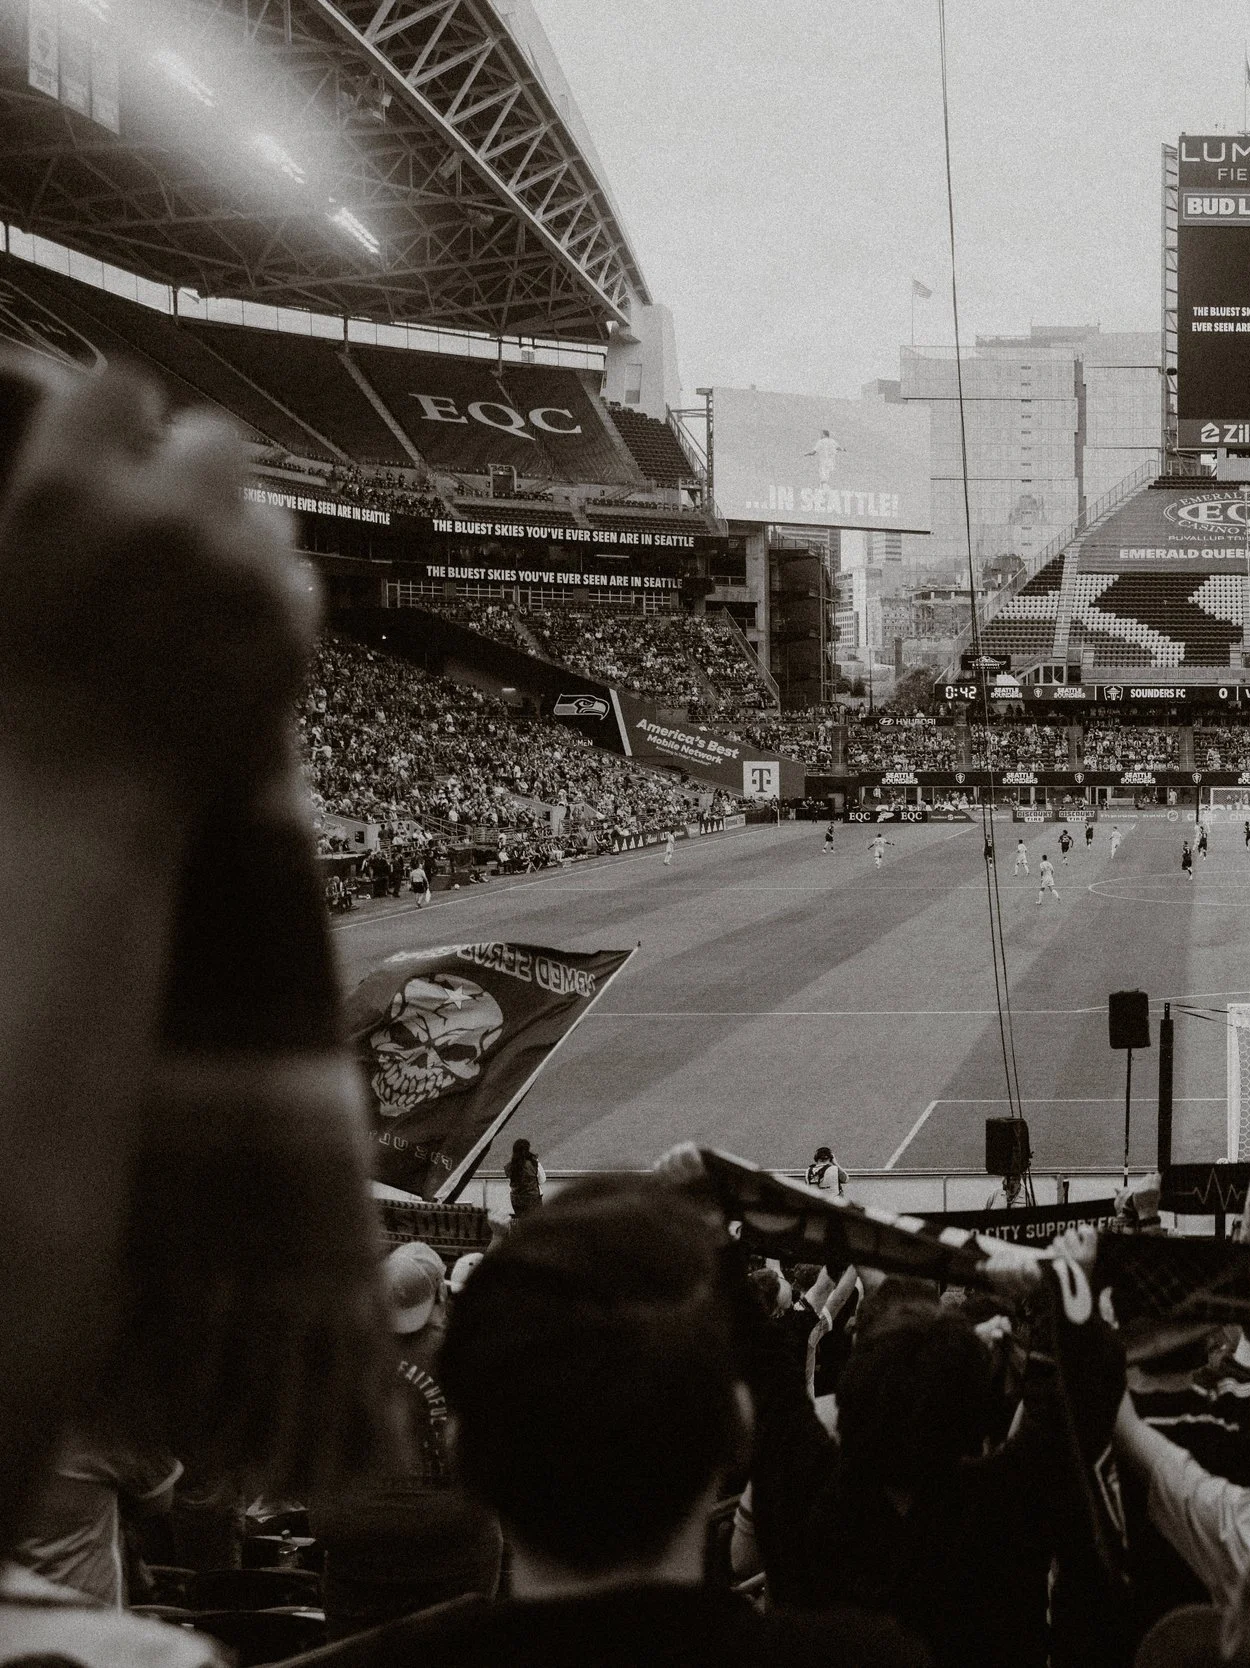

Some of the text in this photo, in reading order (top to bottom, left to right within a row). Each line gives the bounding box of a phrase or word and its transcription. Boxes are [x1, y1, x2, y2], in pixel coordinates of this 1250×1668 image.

[1187, 197, 1236, 216] BUD
[1193, 306, 1208, 317] THE
[1210, 306, 1240, 317] BLUEST
[1192, 322, 1212, 332] EVER
[1214, 322, 1234, 332] SEEN
[408, 393, 582, 441] EQC
[267, 491, 297, 509] YOU'VE
[297, 497, 317, 512] EVER
[318, 501, 337, 517] SEEN
[337, 504, 352, 519] ARE
[352, 506, 361, 520] IN
[362, 508, 390, 525] SEATTLE
[433, 519, 694, 547] THE BLUEST SKIES YOU'VE EVER SEEN ARE IN SEATTLE
[1178, 519, 1240, 535] CASINO
[1119, 549, 1199, 560] EMERALD
[427, 565, 683, 589] THE BLUEST SKIES YOU'VE EVER SEEN ARE IN SEATTLE
[945, 686, 977, 699] 0:42
[1130, 688, 1186, 698] SOUNDERS FC
[1219, 688, 1228, 699] 0
[636, 718, 706, 749] America's
[707, 740, 739, 759] Best
[647, 734, 680, 753] Mobile
[680, 744, 723, 764] Network
[850, 811, 871, 821] EQC
[901, 811, 922, 821] EQC
